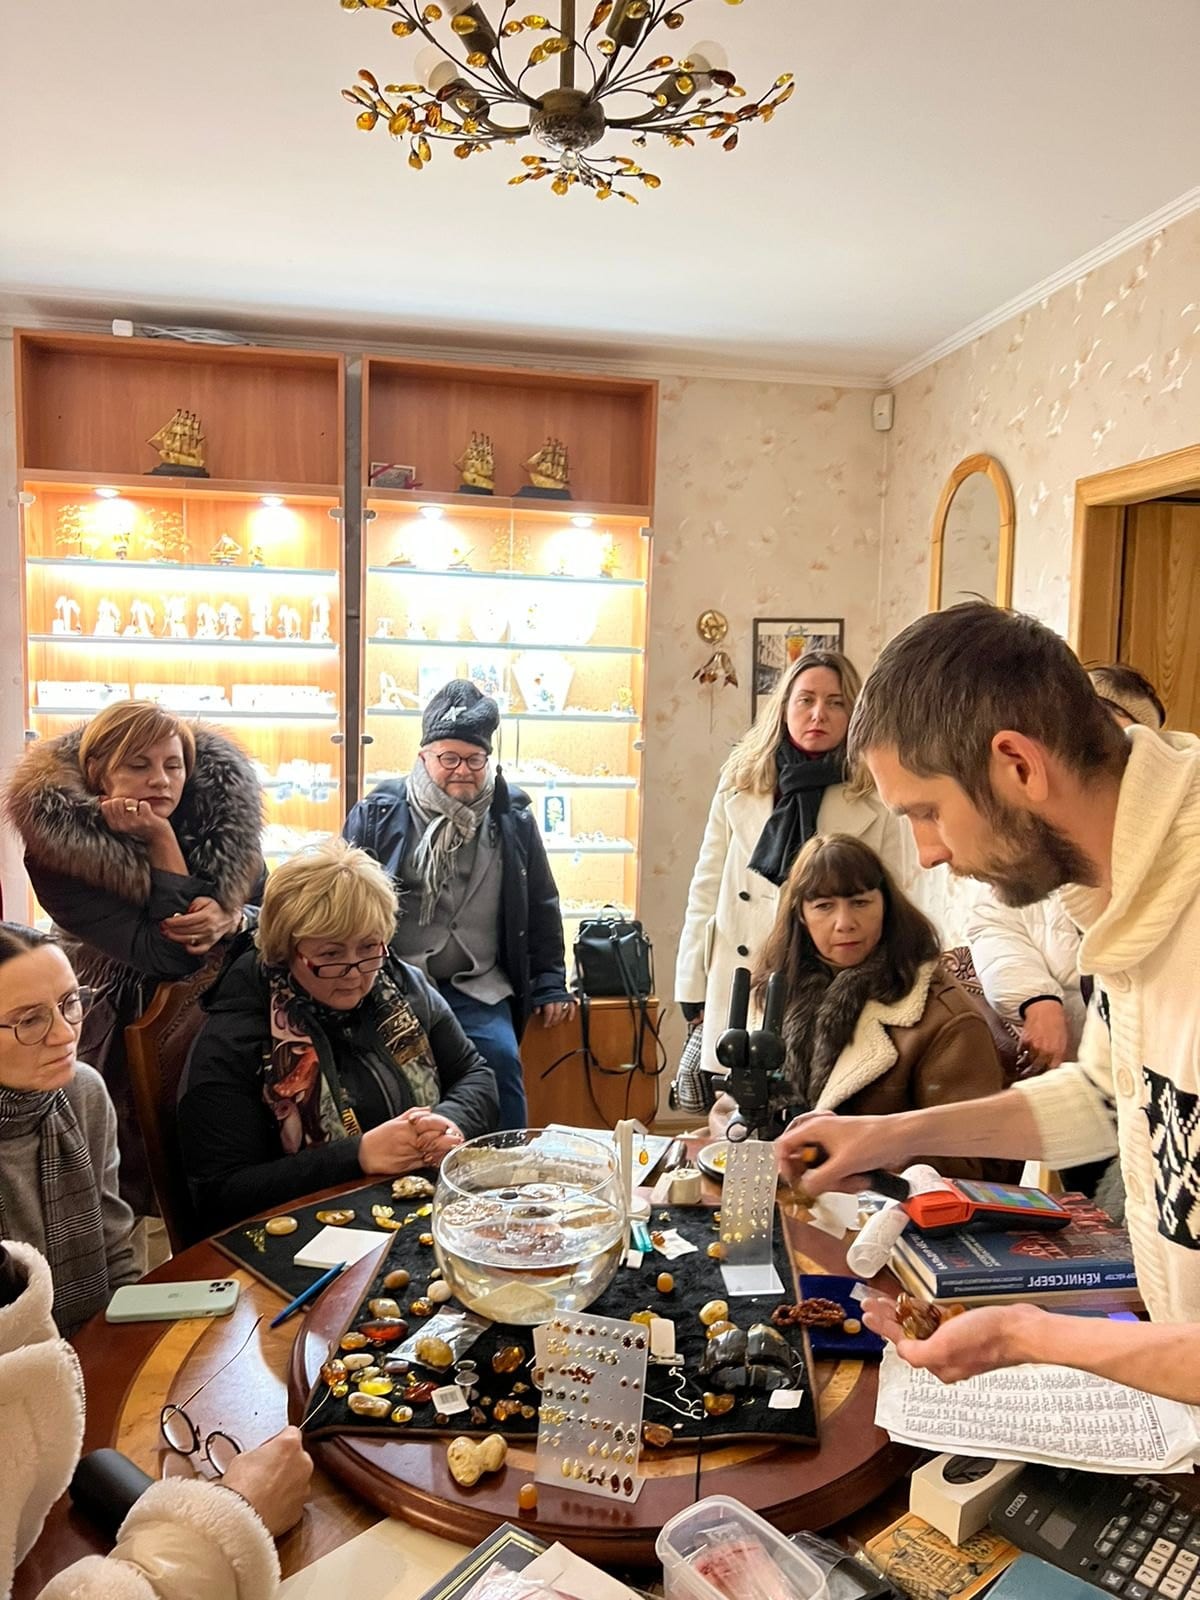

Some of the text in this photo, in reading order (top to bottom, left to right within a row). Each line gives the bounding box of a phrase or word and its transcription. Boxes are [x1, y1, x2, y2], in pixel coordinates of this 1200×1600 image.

[1027, 1272, 1101, 1288] КЁНИГСБЕРГ
[1141, 1543, 1170, 1579] 7 8 9
[1165, 1554, 1194, 1591] 4 5 6
